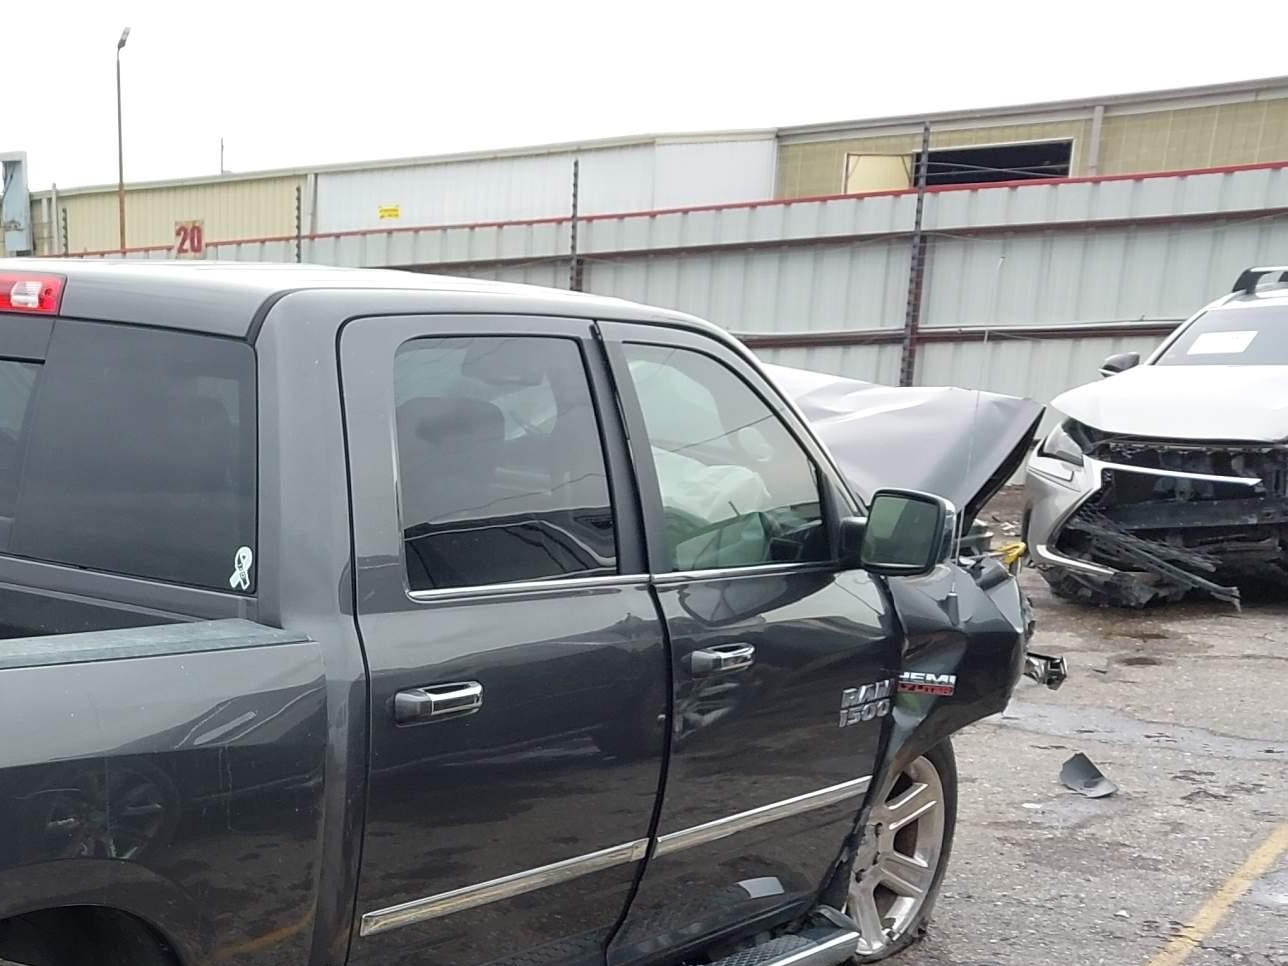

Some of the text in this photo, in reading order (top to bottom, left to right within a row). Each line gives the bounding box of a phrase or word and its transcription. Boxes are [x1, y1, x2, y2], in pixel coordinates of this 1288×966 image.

[175, 225, 203, 254] 20
[841, 679, 893, 708] RAM
[838, 698, 891, 728] 1500
